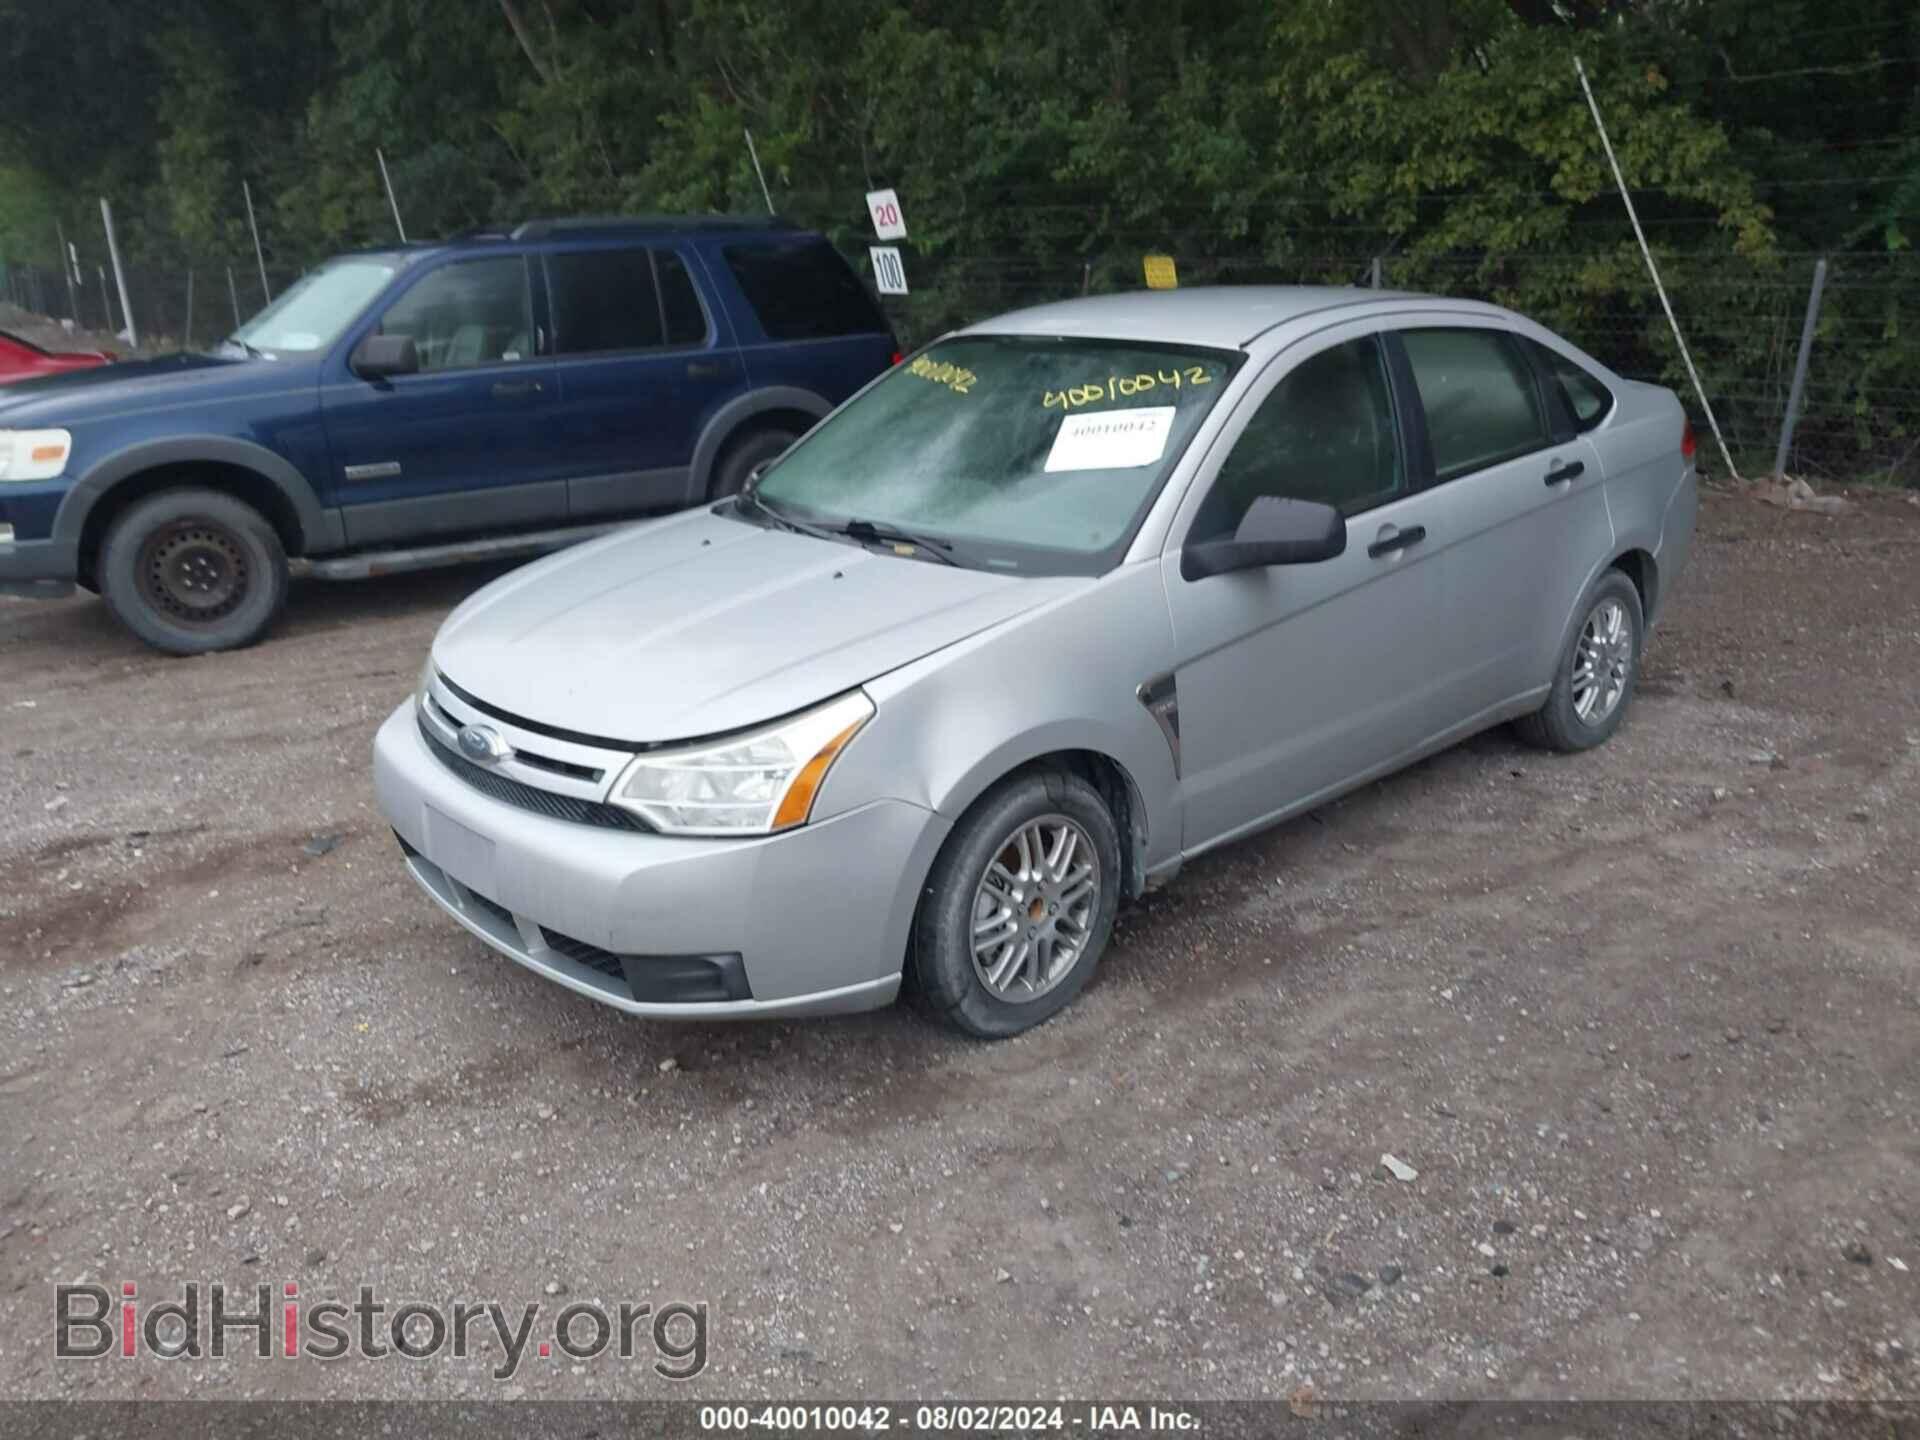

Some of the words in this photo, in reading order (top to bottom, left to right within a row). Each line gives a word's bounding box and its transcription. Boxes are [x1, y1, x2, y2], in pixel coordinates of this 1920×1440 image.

[875, 202, 898, 227] 20
[876, 251, 903, 290] 100
[1043, 366, 1212, 410] 40010042
